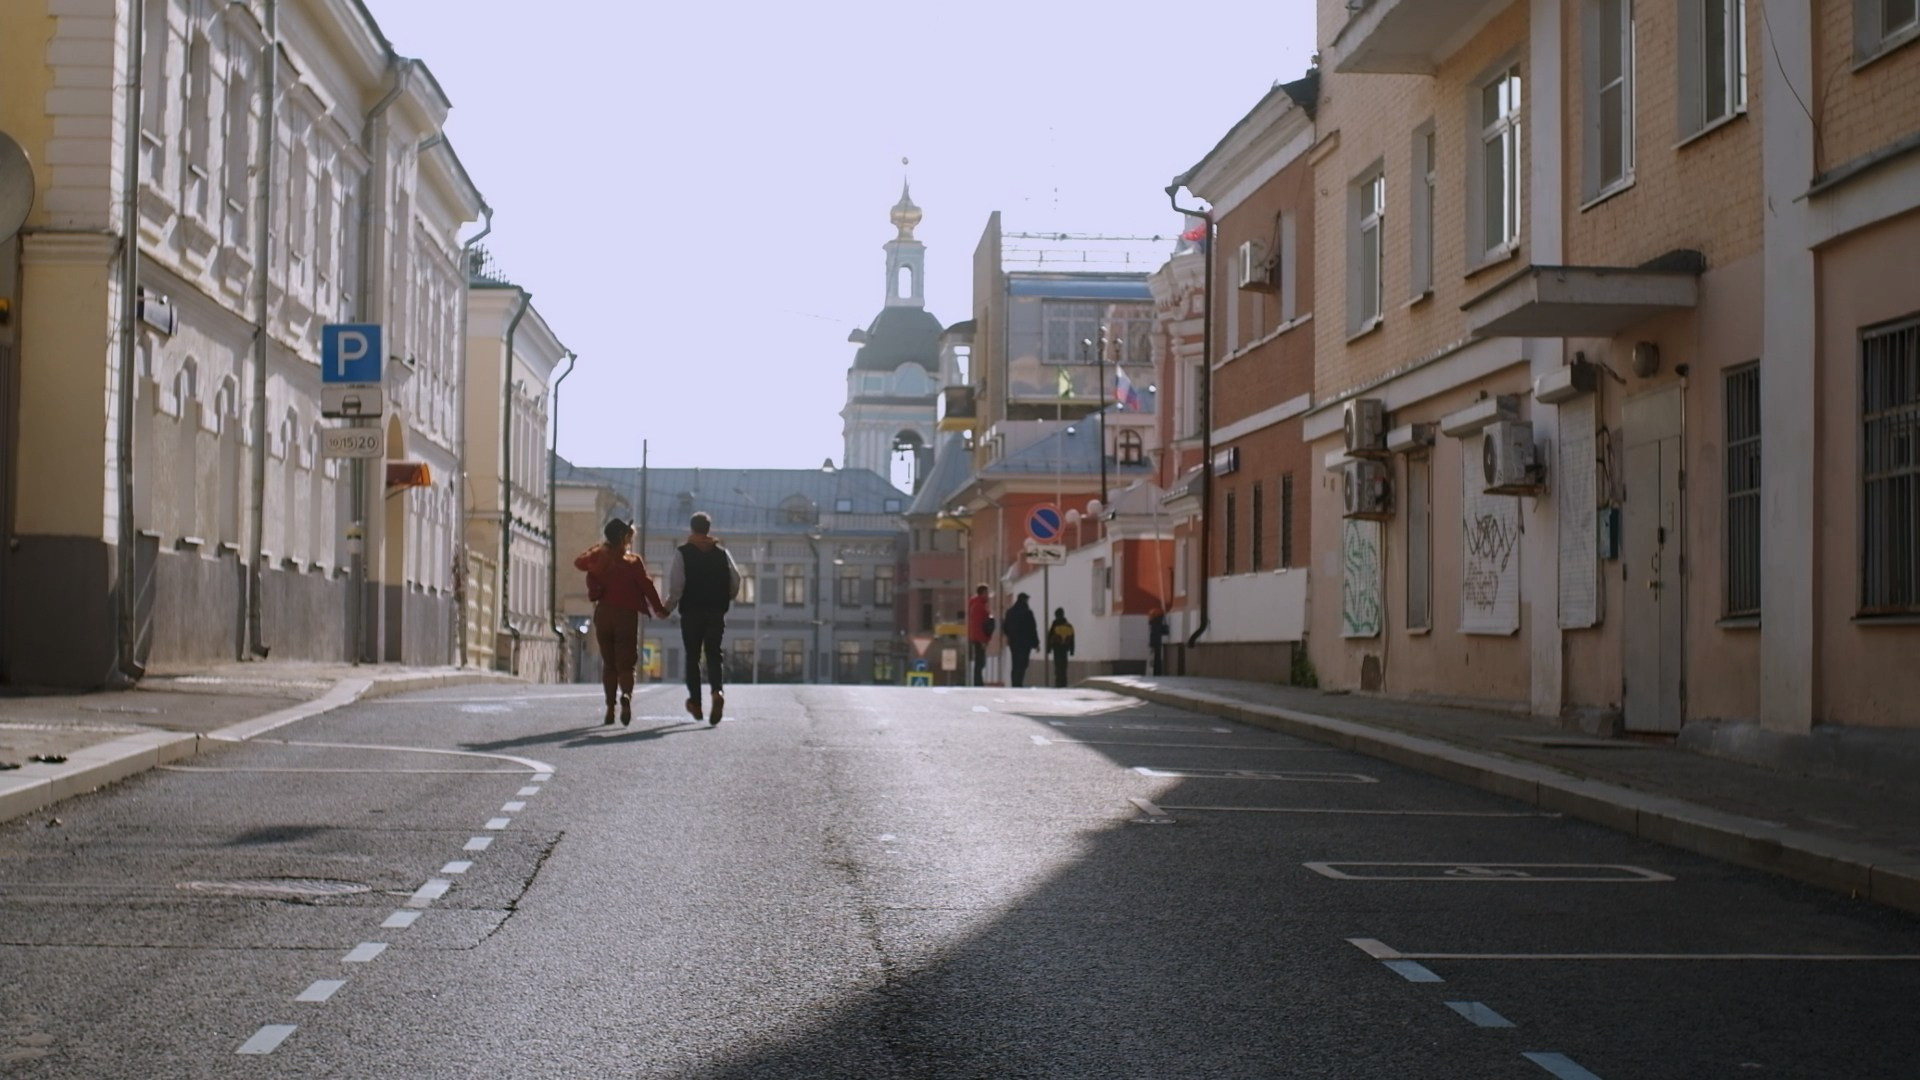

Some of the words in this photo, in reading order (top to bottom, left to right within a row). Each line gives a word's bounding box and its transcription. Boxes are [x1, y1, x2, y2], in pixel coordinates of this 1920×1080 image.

[338, 331, 368, 376] P
[343, 437, 354, 448] 15
[358, 436, 376, 449] 20
